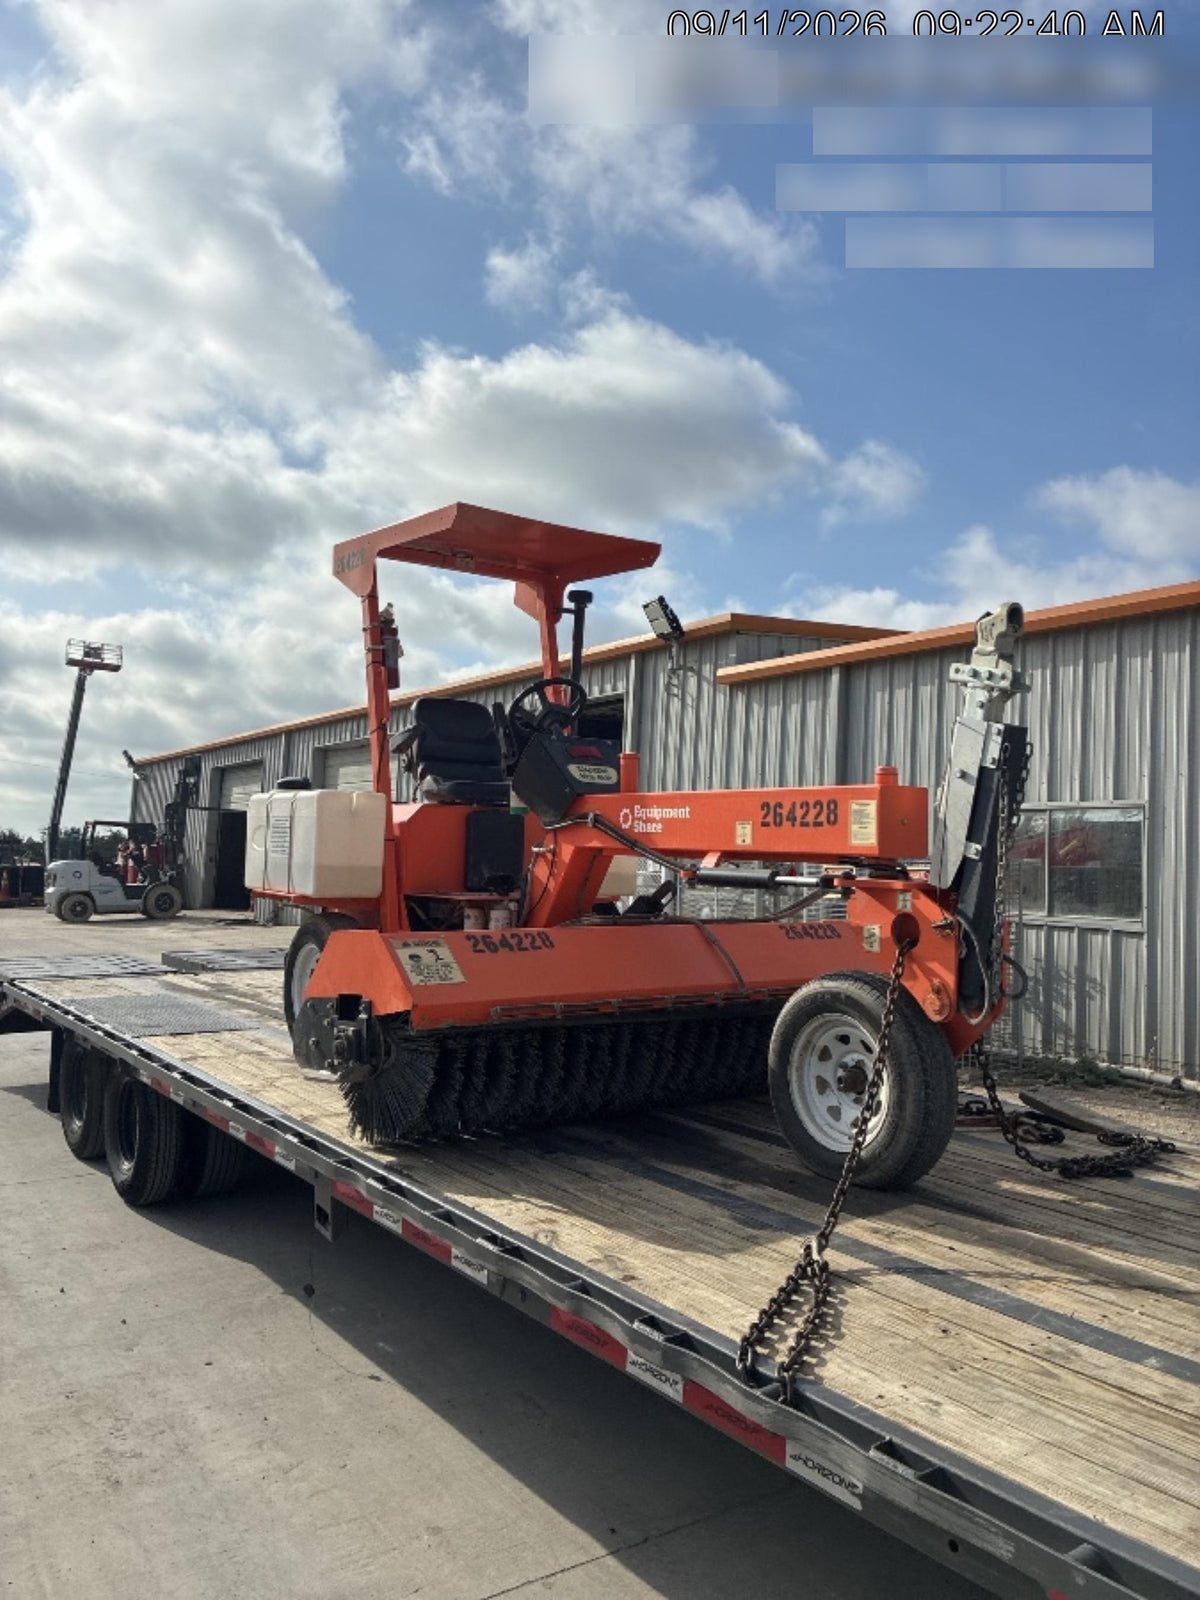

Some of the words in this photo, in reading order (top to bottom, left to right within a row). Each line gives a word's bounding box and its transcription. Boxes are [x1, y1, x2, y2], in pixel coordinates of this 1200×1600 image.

[634, 805, 690, 820] Equipment
[760, 799, 838, 828] 264228
[634, 820, 663, 833] Share
[777, 924, 842, 939] 264228
[465, 931, 555, 953] 264228
[789, 1453, 859, 1490] HORIZON
